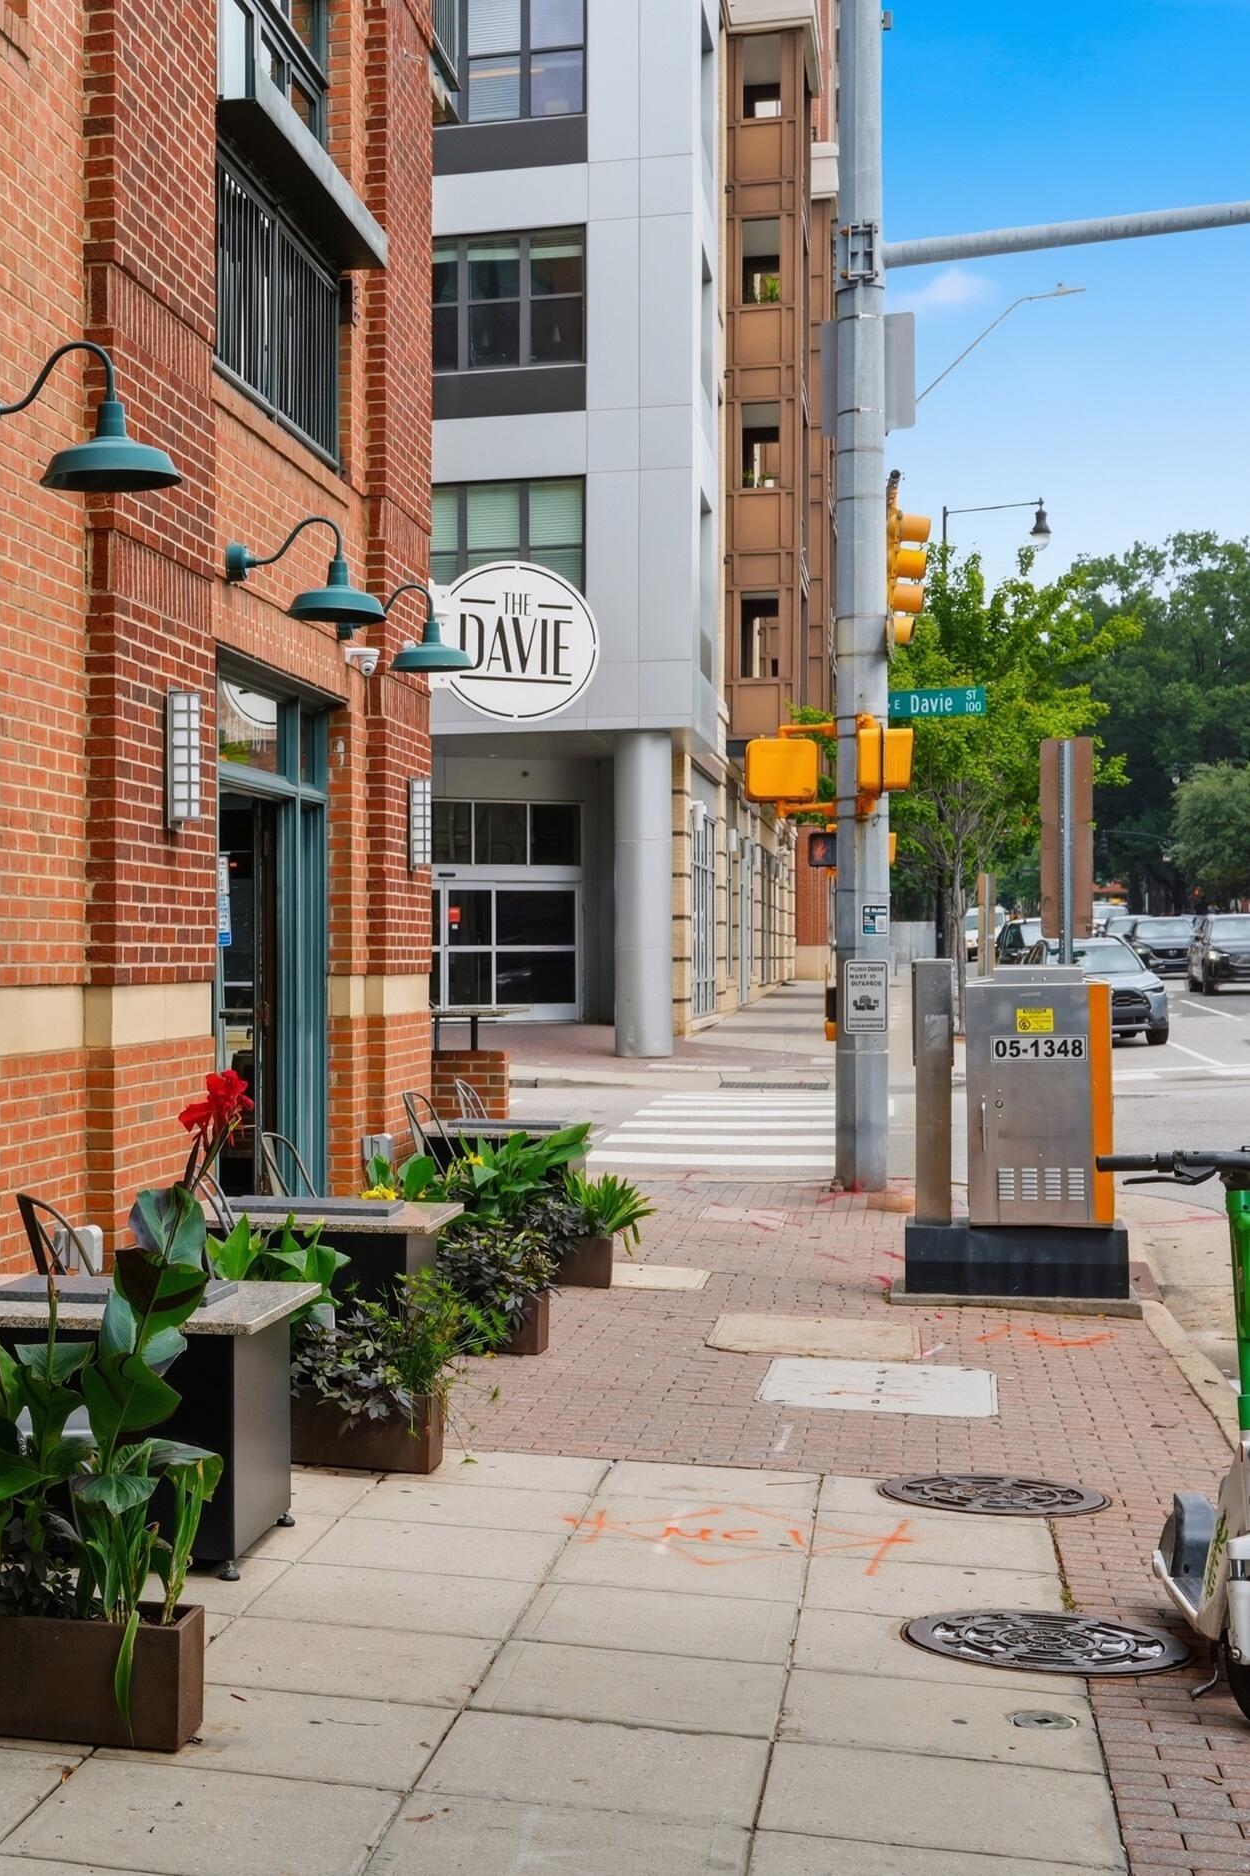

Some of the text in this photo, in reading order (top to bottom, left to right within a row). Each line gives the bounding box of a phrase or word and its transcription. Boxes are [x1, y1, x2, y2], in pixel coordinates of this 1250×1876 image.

[502, 592, 533, 617] THE
[459, 613, 573, 677] DAVIE
[894, 690, 977, 714] E Davie ST
[965, 701, 982, 712] 100
[994, 1039, 1084, 1058] 05-1348
